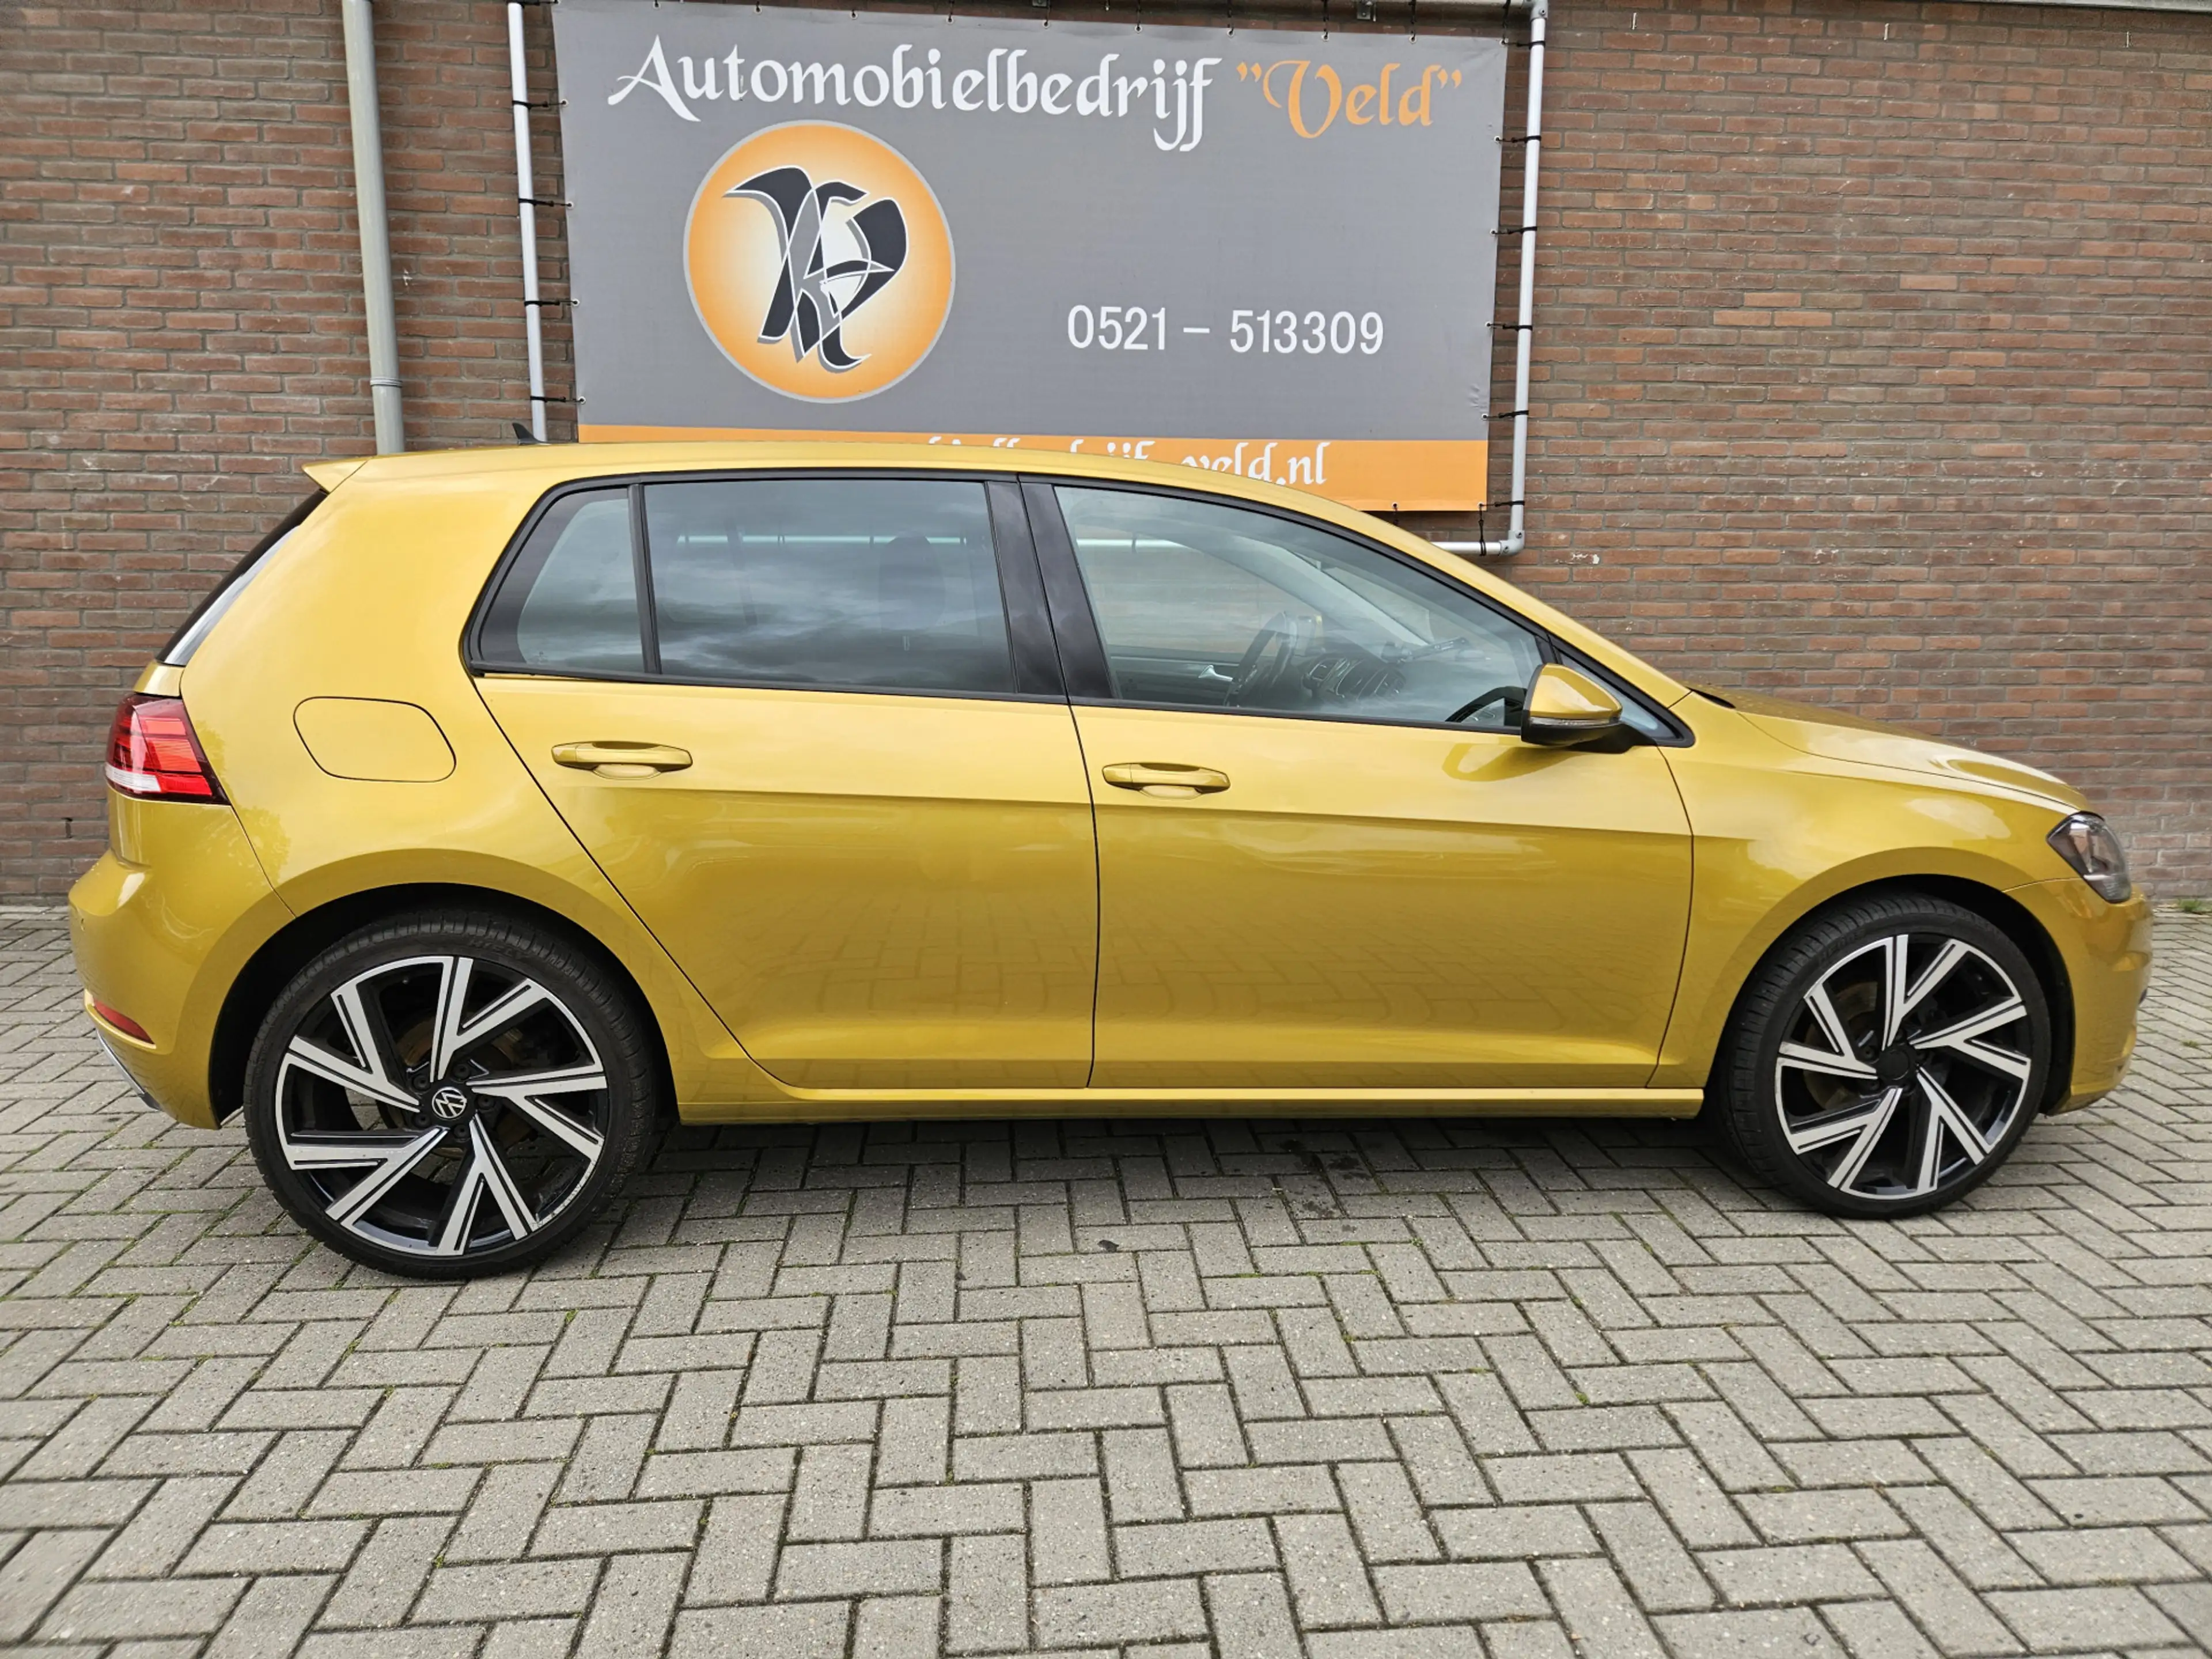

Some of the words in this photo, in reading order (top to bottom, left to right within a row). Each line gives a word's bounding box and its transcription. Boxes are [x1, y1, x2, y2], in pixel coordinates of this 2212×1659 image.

[608, 36, 1221, 151] Automobielbedrijf
[1237, 61, 1461, 137] "Veld"
[1069, 305, 1165, 349] 0521
[1231, 310, 1382, 354] 513309
